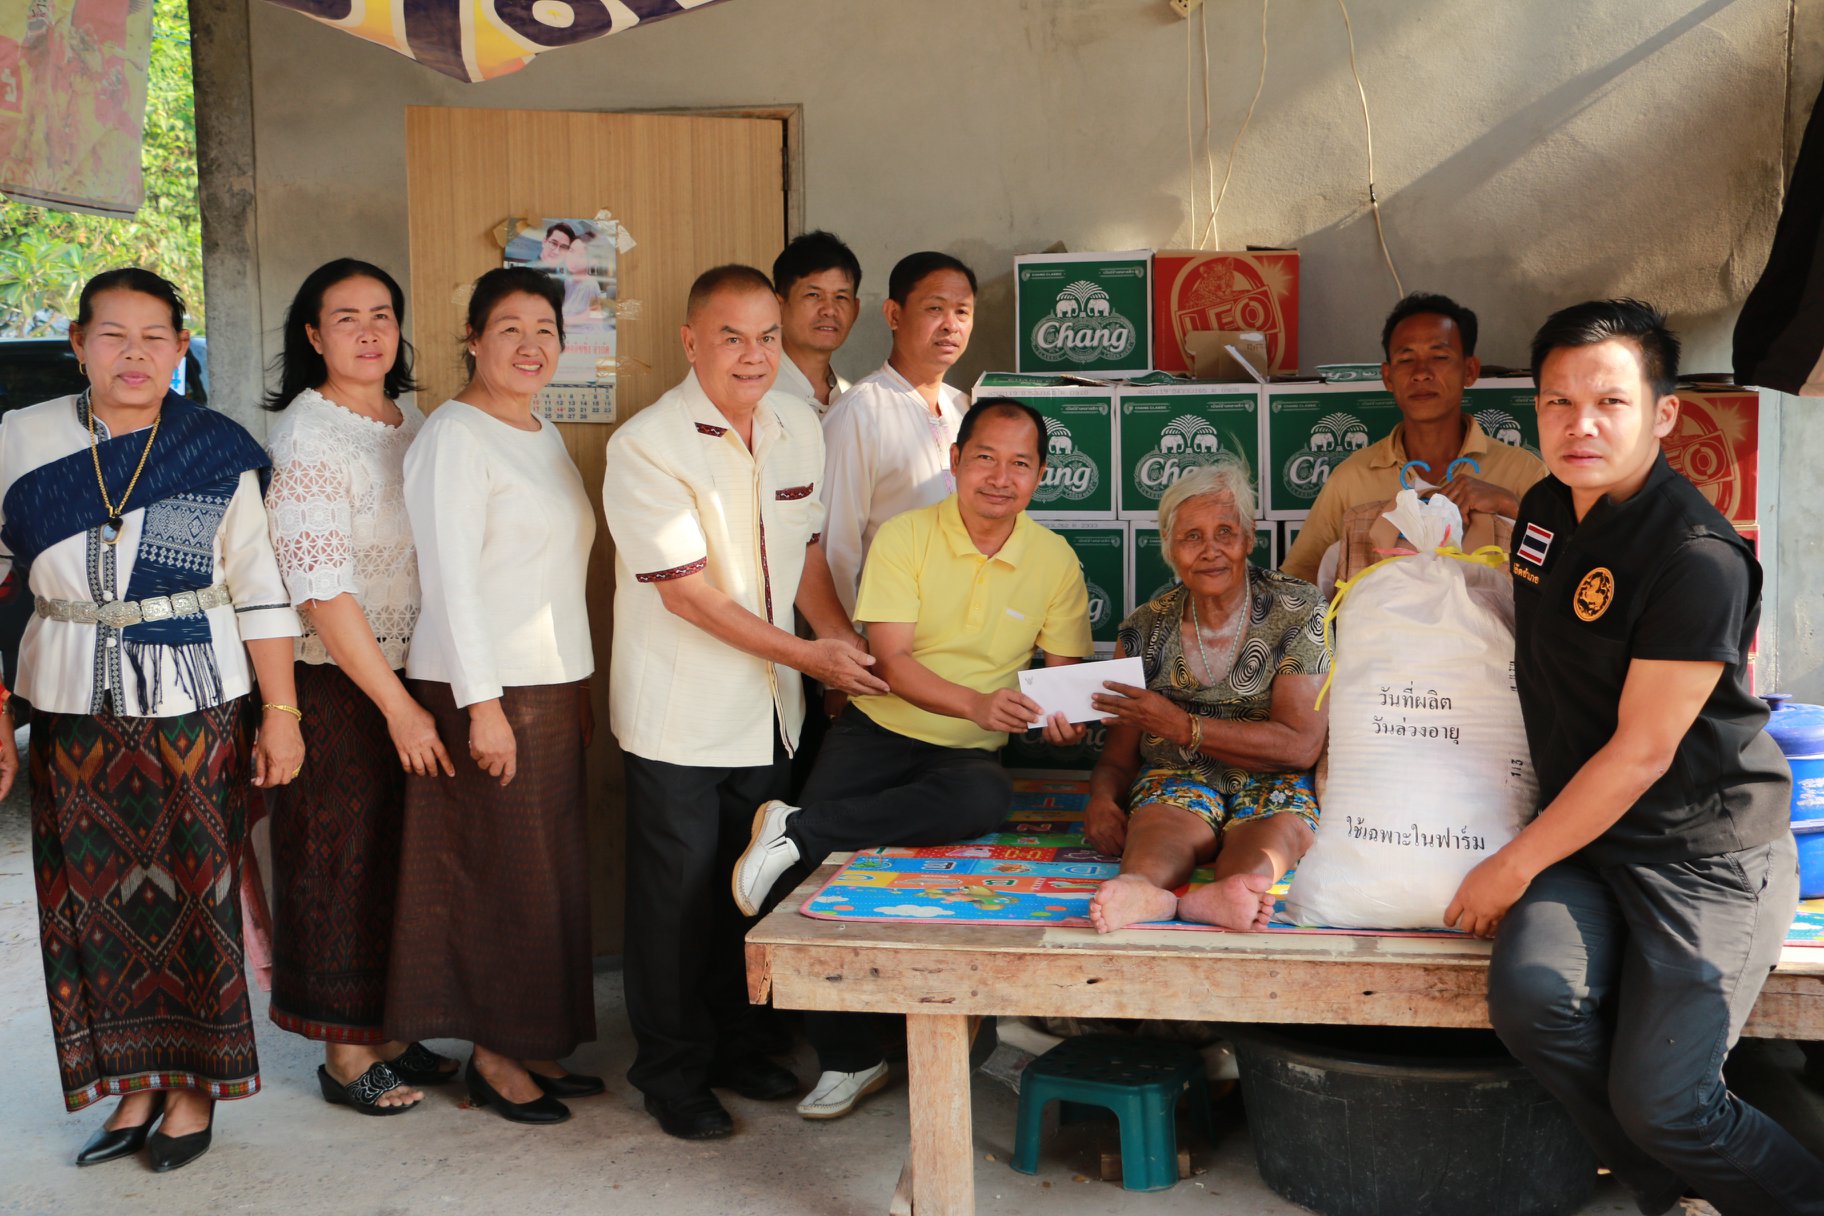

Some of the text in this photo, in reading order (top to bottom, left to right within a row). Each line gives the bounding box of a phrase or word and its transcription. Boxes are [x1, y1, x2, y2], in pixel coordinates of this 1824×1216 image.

[1036, 320, 1130, 353] Chang
[1039, 465, 1093, 492] ang
[1379, 680, 1453, 710] วันที่ผลิต
[1372, 715, 1460, 745] วันล่วงอายุ
[1345, 815, 1486, 851] ใช้เฉพาะในฟาร์ม
